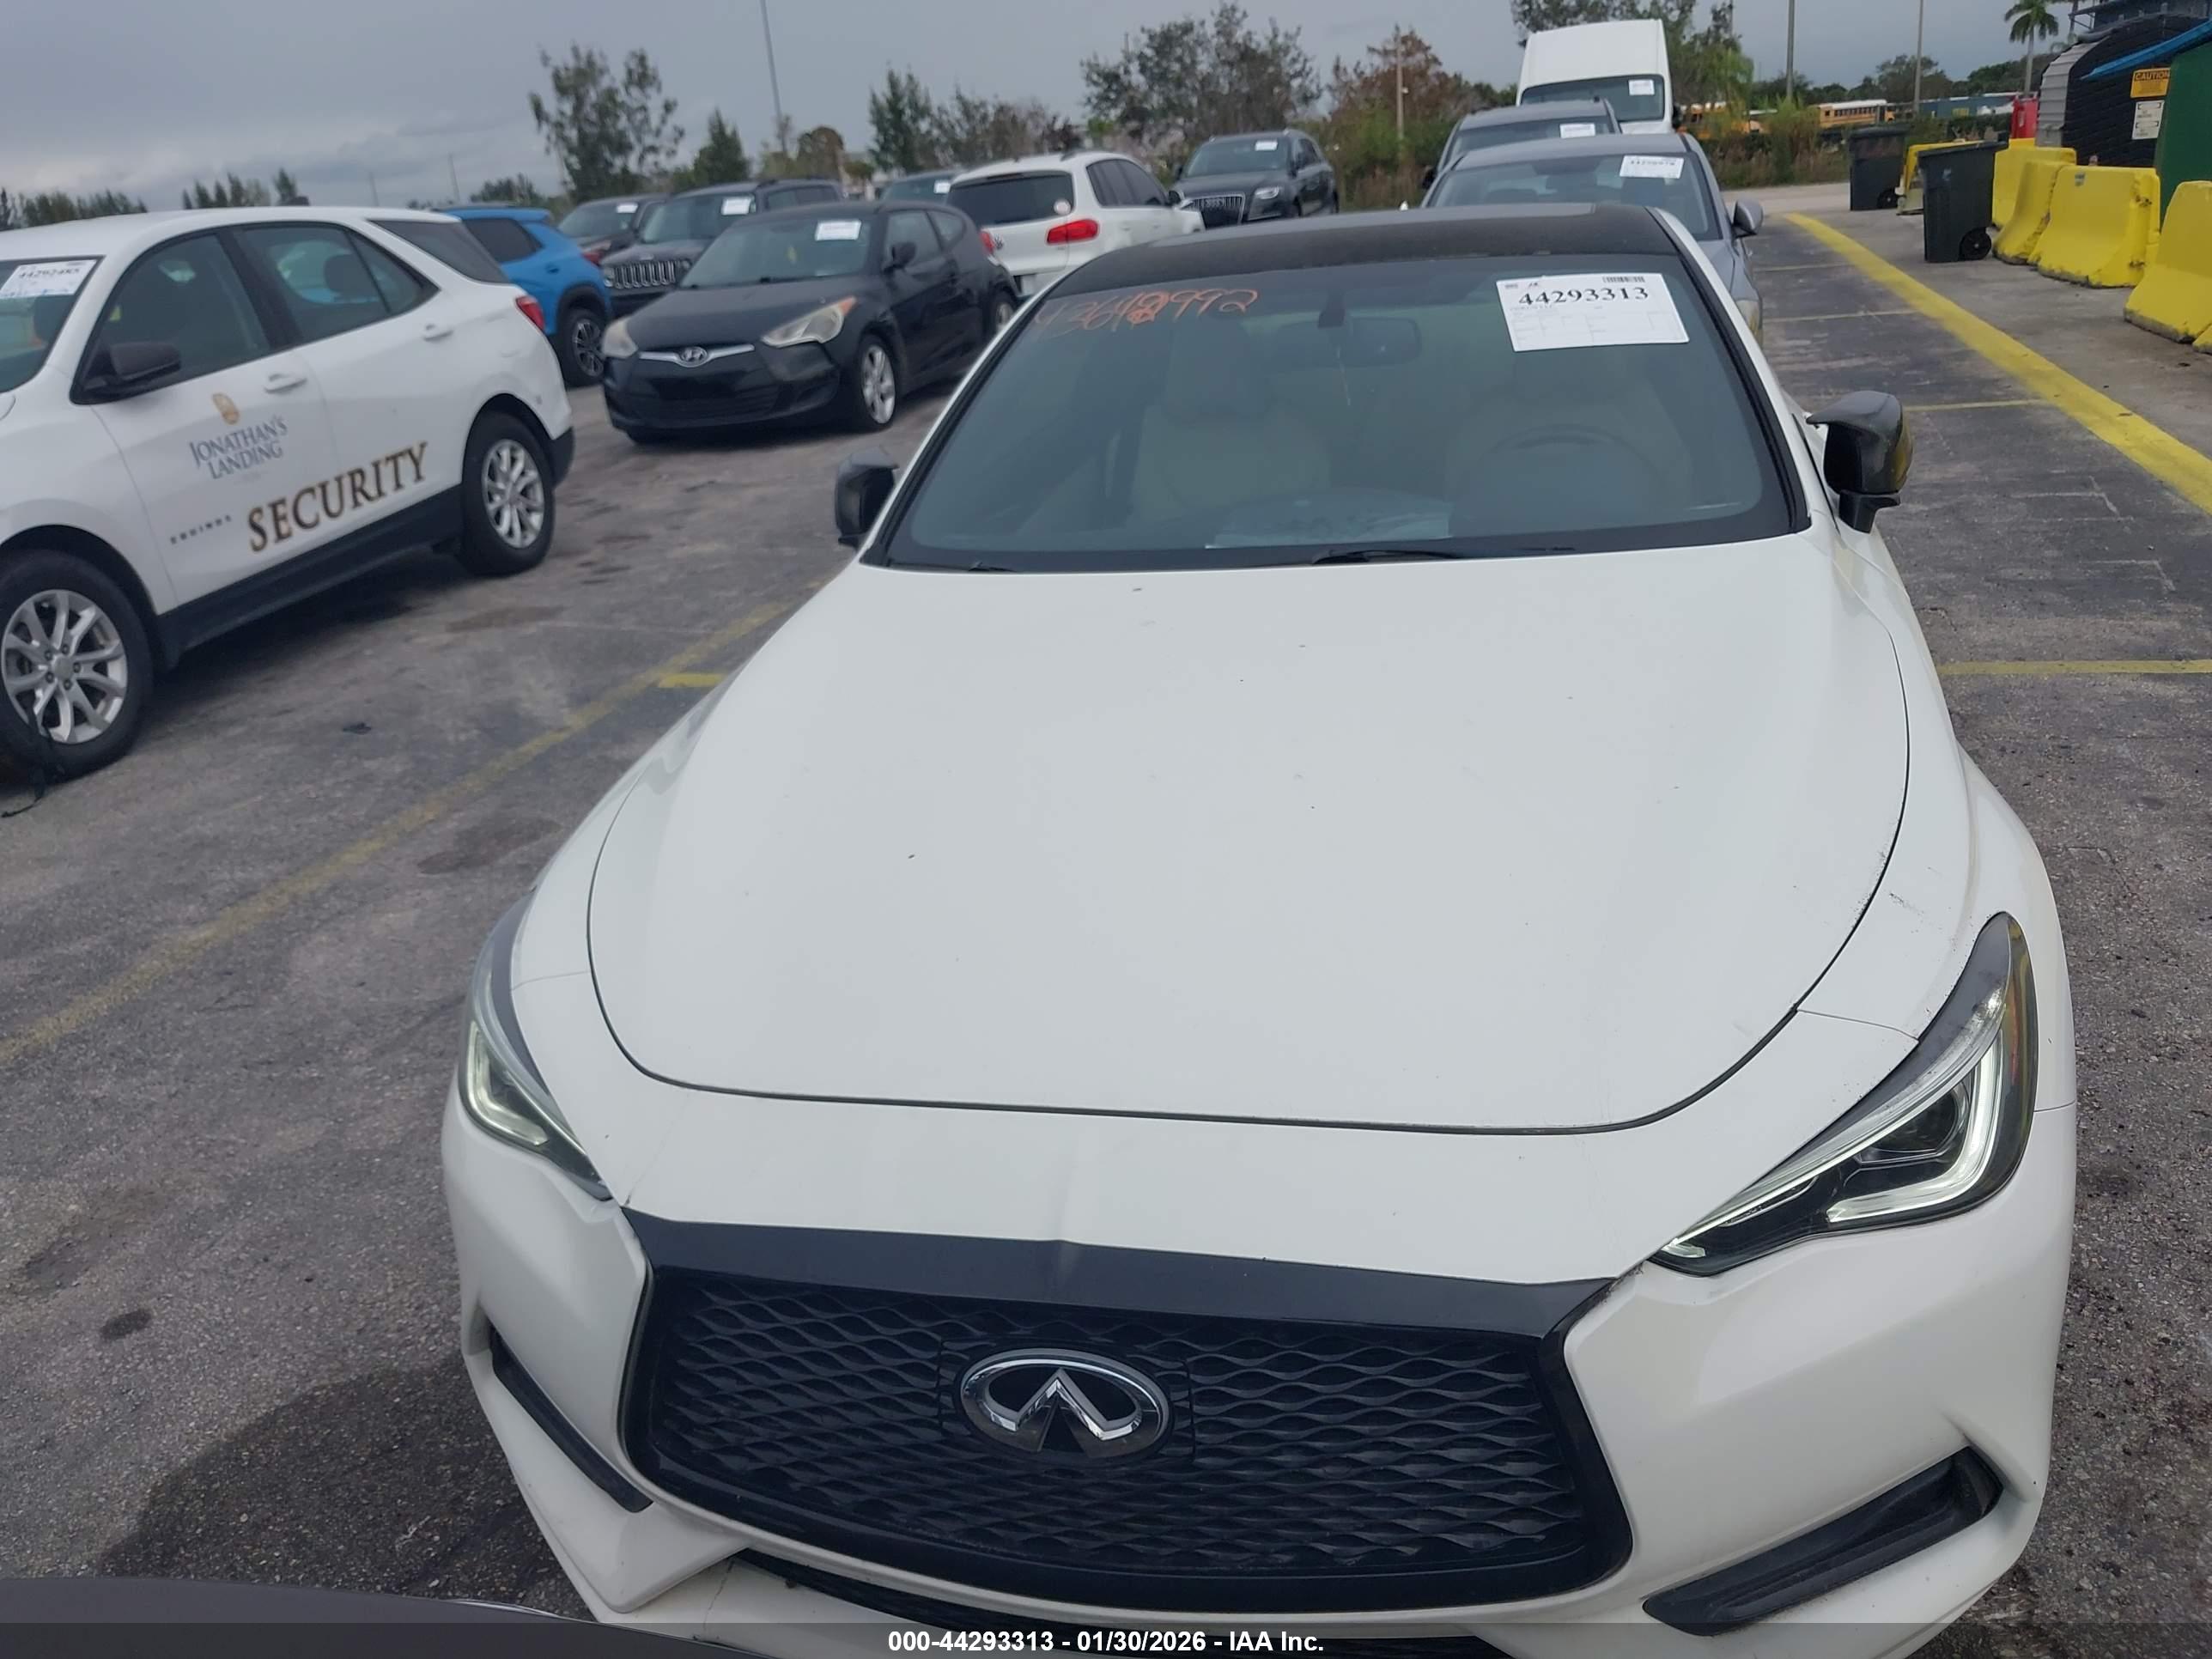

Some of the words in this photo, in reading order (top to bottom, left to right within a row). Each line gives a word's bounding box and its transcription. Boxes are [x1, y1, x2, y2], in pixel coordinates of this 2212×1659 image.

[1519, 286, 1649, 305] 44293313
[189, 416, 288, 468] JONATHAN'S
[207, 440, 283, 479] LANDING
[247, 441, 428, 552] SECURITY
